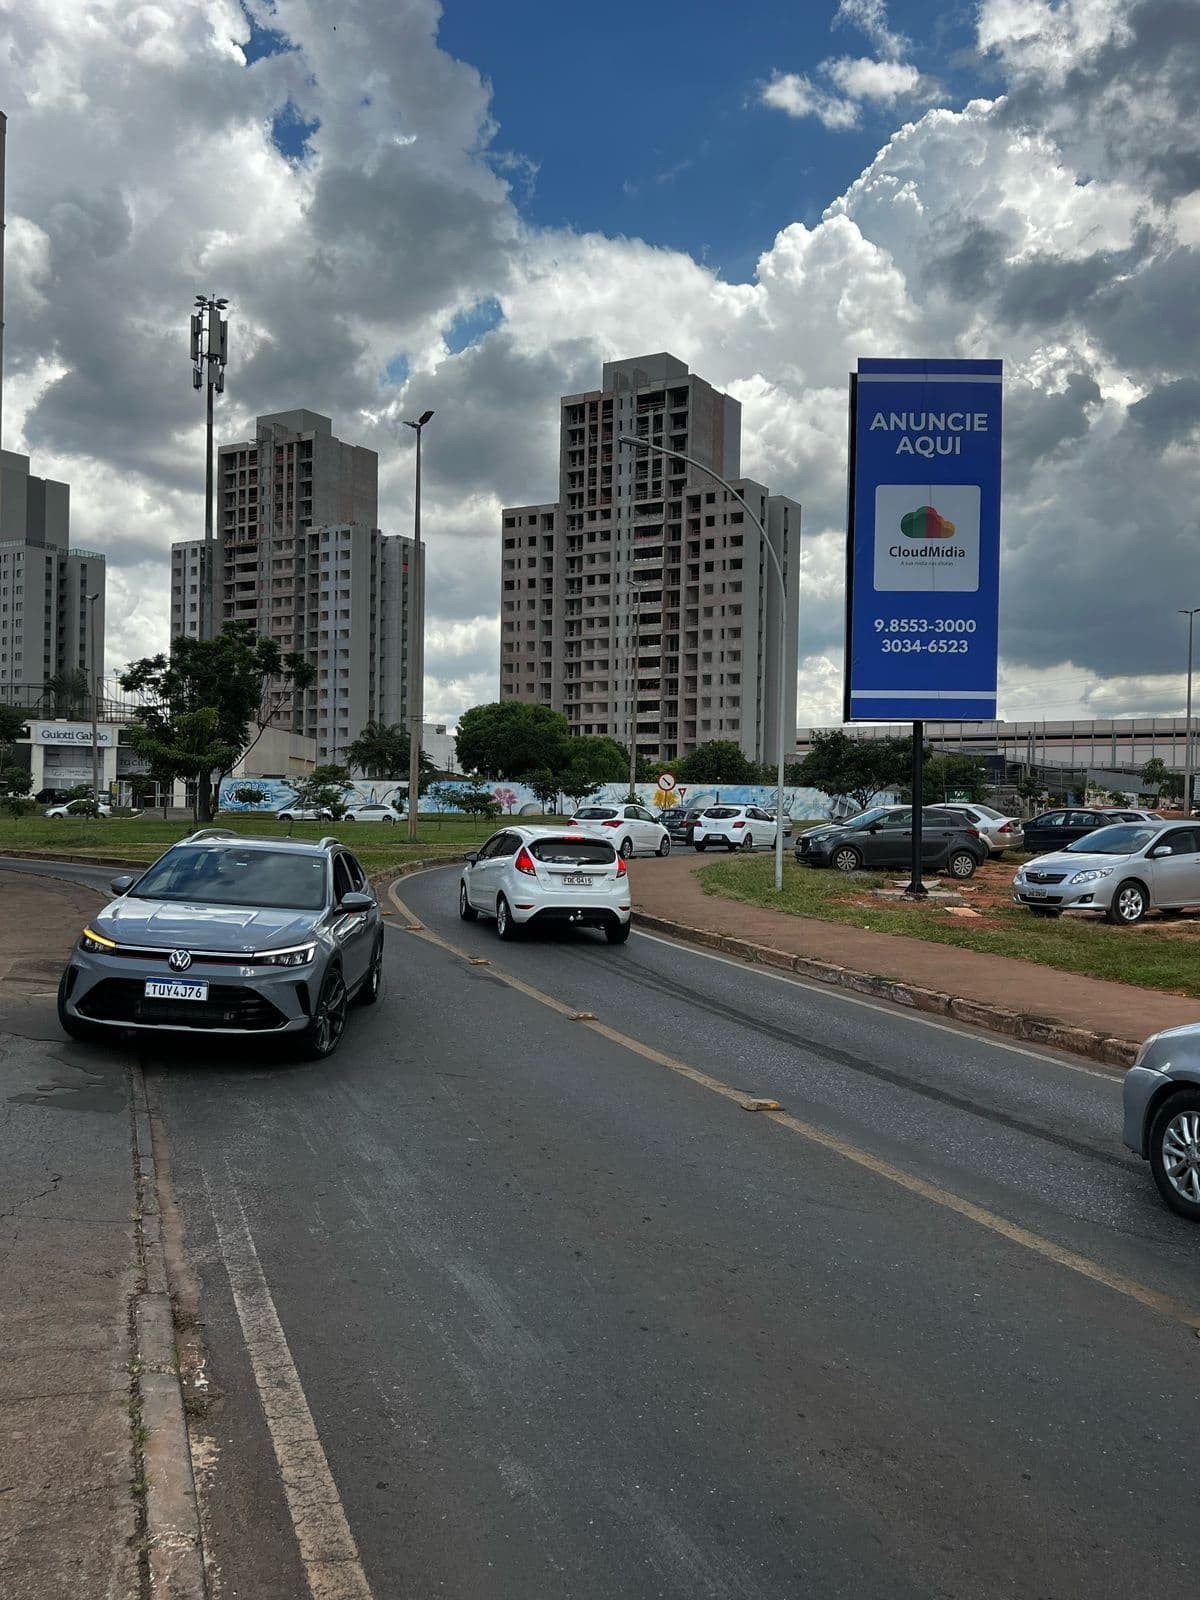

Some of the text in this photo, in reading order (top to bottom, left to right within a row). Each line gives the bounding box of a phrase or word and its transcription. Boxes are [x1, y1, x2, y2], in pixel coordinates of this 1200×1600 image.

[869, 412, 988, 431] ANUNCIE
[895, 436, 961, 458] AQUI
[888, 545, 966, 558] CloudMídia
[874, 618, 977, 633] 9.8553-3000
[881, 639, 969, 653] 3034-6523
[152, 984, 202, 998] TUY4J76
